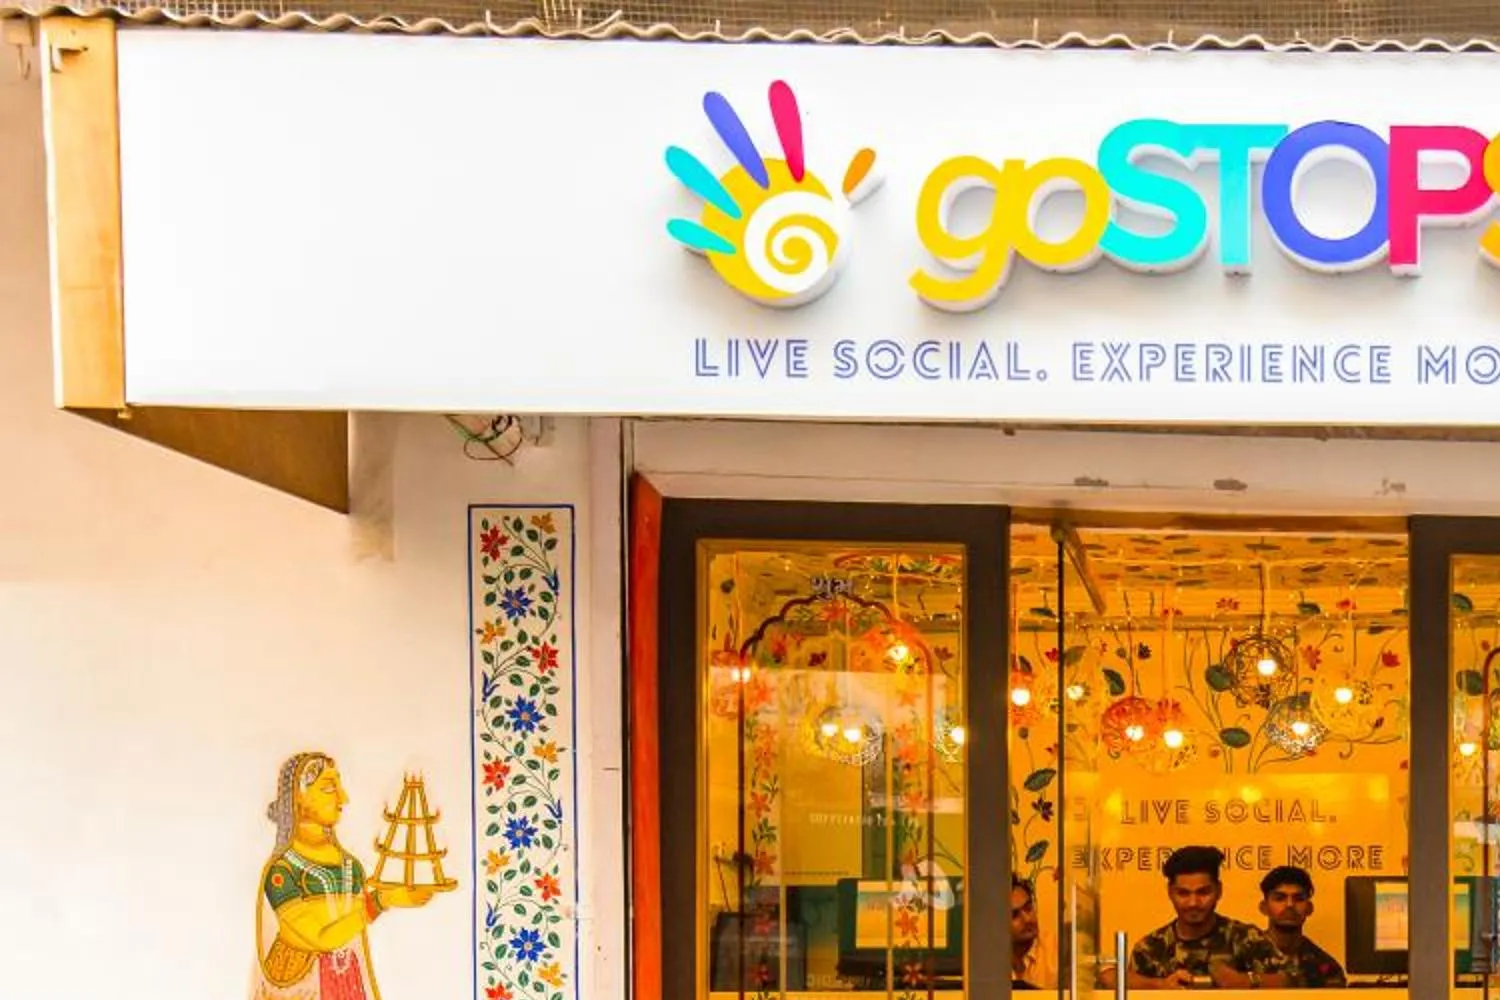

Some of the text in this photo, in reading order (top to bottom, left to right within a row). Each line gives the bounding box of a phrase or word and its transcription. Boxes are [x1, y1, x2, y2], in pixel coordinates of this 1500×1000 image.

[694, 338, 809, 378] LIVE
[832, 339, 1049, 382] SOCIAL.
[1071, 341, 1393, 383] EXPERIENCE
[1120, 800, 1337, 824] LIVE SOCIAL.
[1073, 845, 1383, 871] XPERCE MORE
